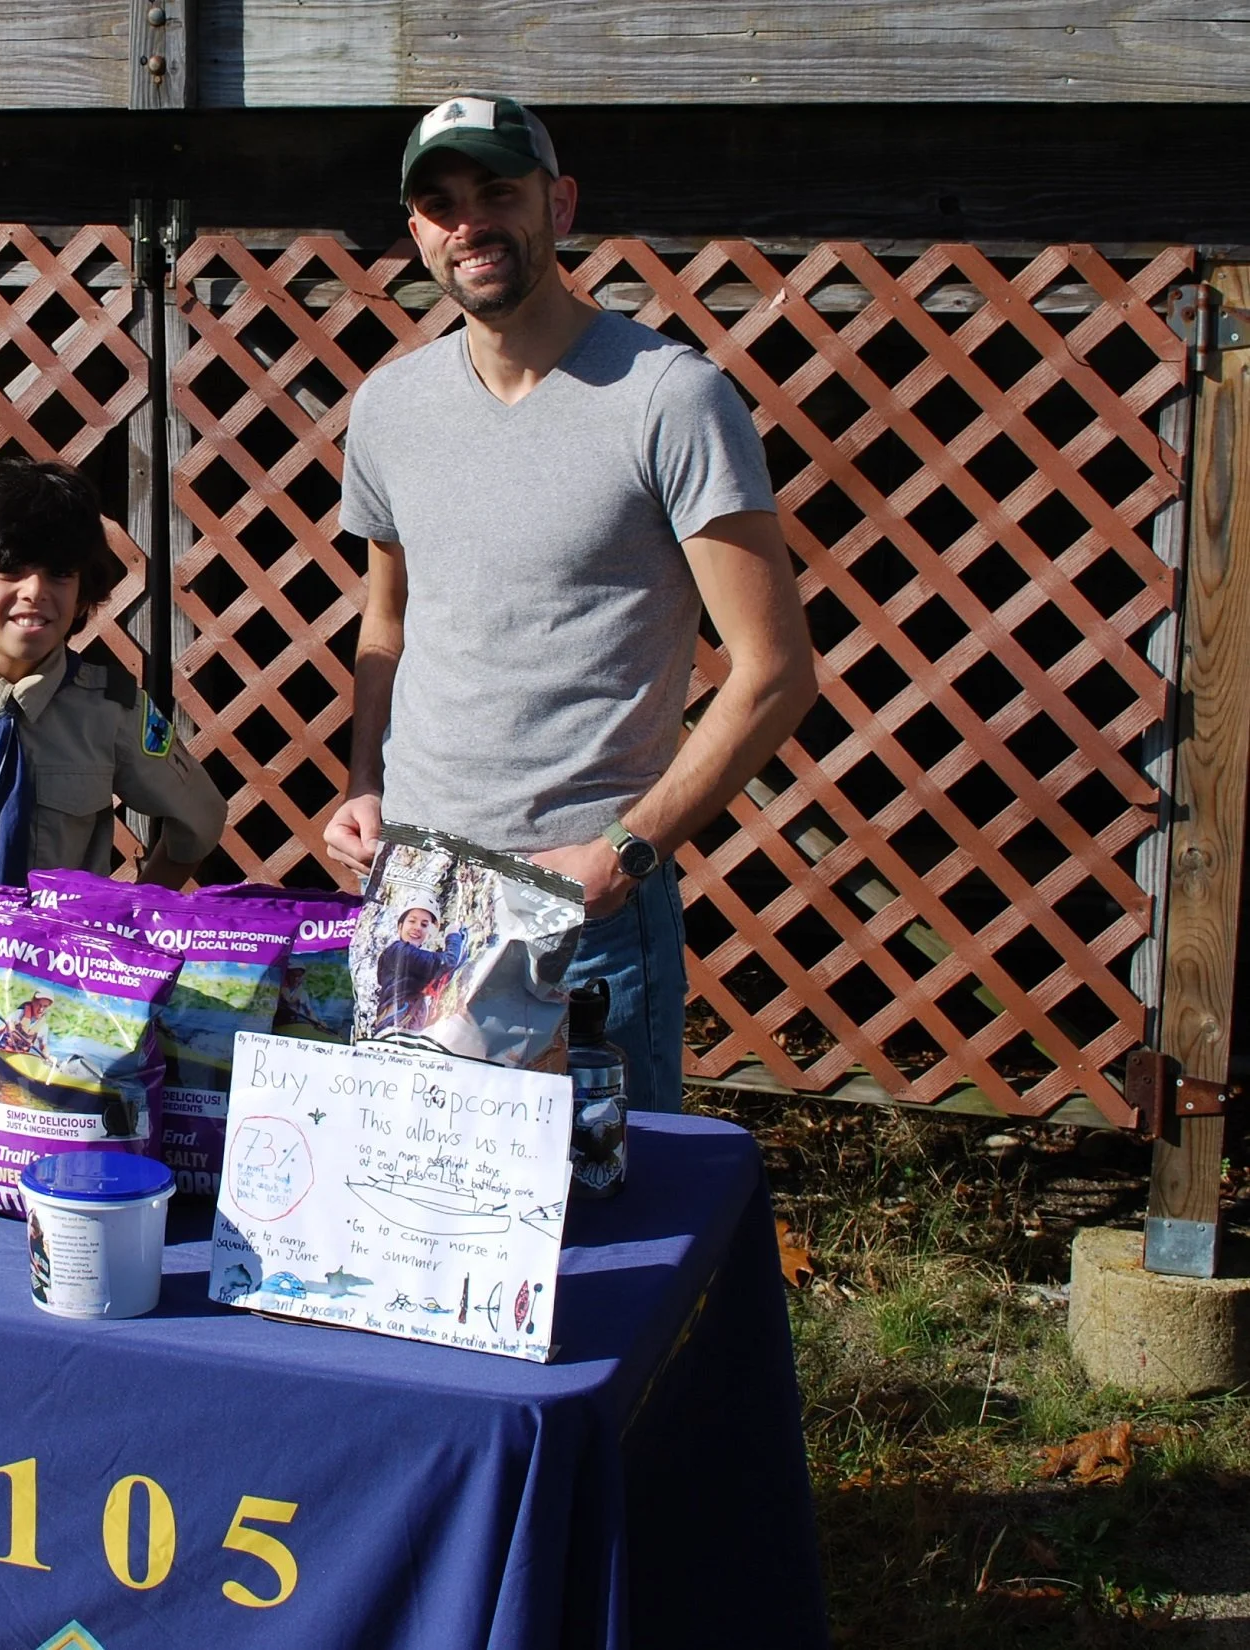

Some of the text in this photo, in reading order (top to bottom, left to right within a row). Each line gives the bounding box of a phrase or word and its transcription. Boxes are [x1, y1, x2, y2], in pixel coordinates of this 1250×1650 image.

[144, 929, 292, 950] YOU FOR SUPPORTING
[299, 917, 357, 941] OU FOR
[333, 928, 356, 940] LOC
[192, 940, 258, 953] LOCAL KIDS
[47, 949, 90, 979] YOU
[90, 957, 109, 971] FOR
[89, 969, 141, 989] LOCAL KIDS
[237, 1034, 247, 1045] By
[250, 1035, 271, 1050] Troop
[250, 1049, 308, 1106] Buy
[329, 1074, 399, 1101] some
[162, 1090, 222, 1106] DELICIOUS!
[6, 1109, 97, 1130] SIMPLY DELICIOUS!
[6, 1120, 80, 1138] JUST 4 INGREDIENTS
[162, 1128, 199, 1146] End
[358, 1107, 539, 1160] This allows us to...
[242, 1126, 300, 1169] 73%
[165, 1150, 209, 1168] SALTY
[376, 1149, 387, 1159] on
[475, 1160, 501, 1182] stays
[359, 1156, 372, 1168] at
[377, 1159, 399, 1173] cool
[471, 1176, 513, 1200] battleship
[262, 1230, 273, 1242] to
[279, 1234, 307, 1253] camp
[352, 1218, 366, 1234] Go
[377, 1224, 391, 1237] to
[400, 1231, 440, 1255] camp
[496, 1244, 509, 1261] in
[266, 1242, 281, 1258] in
[284, 1247, 320, 1263] June
[350, 1239, 443, 1271] the summer
[364, 1311, 382, 1329] You
[386, 1319, 405, 1334] can
[450, 1332, 488, 1350] donation
